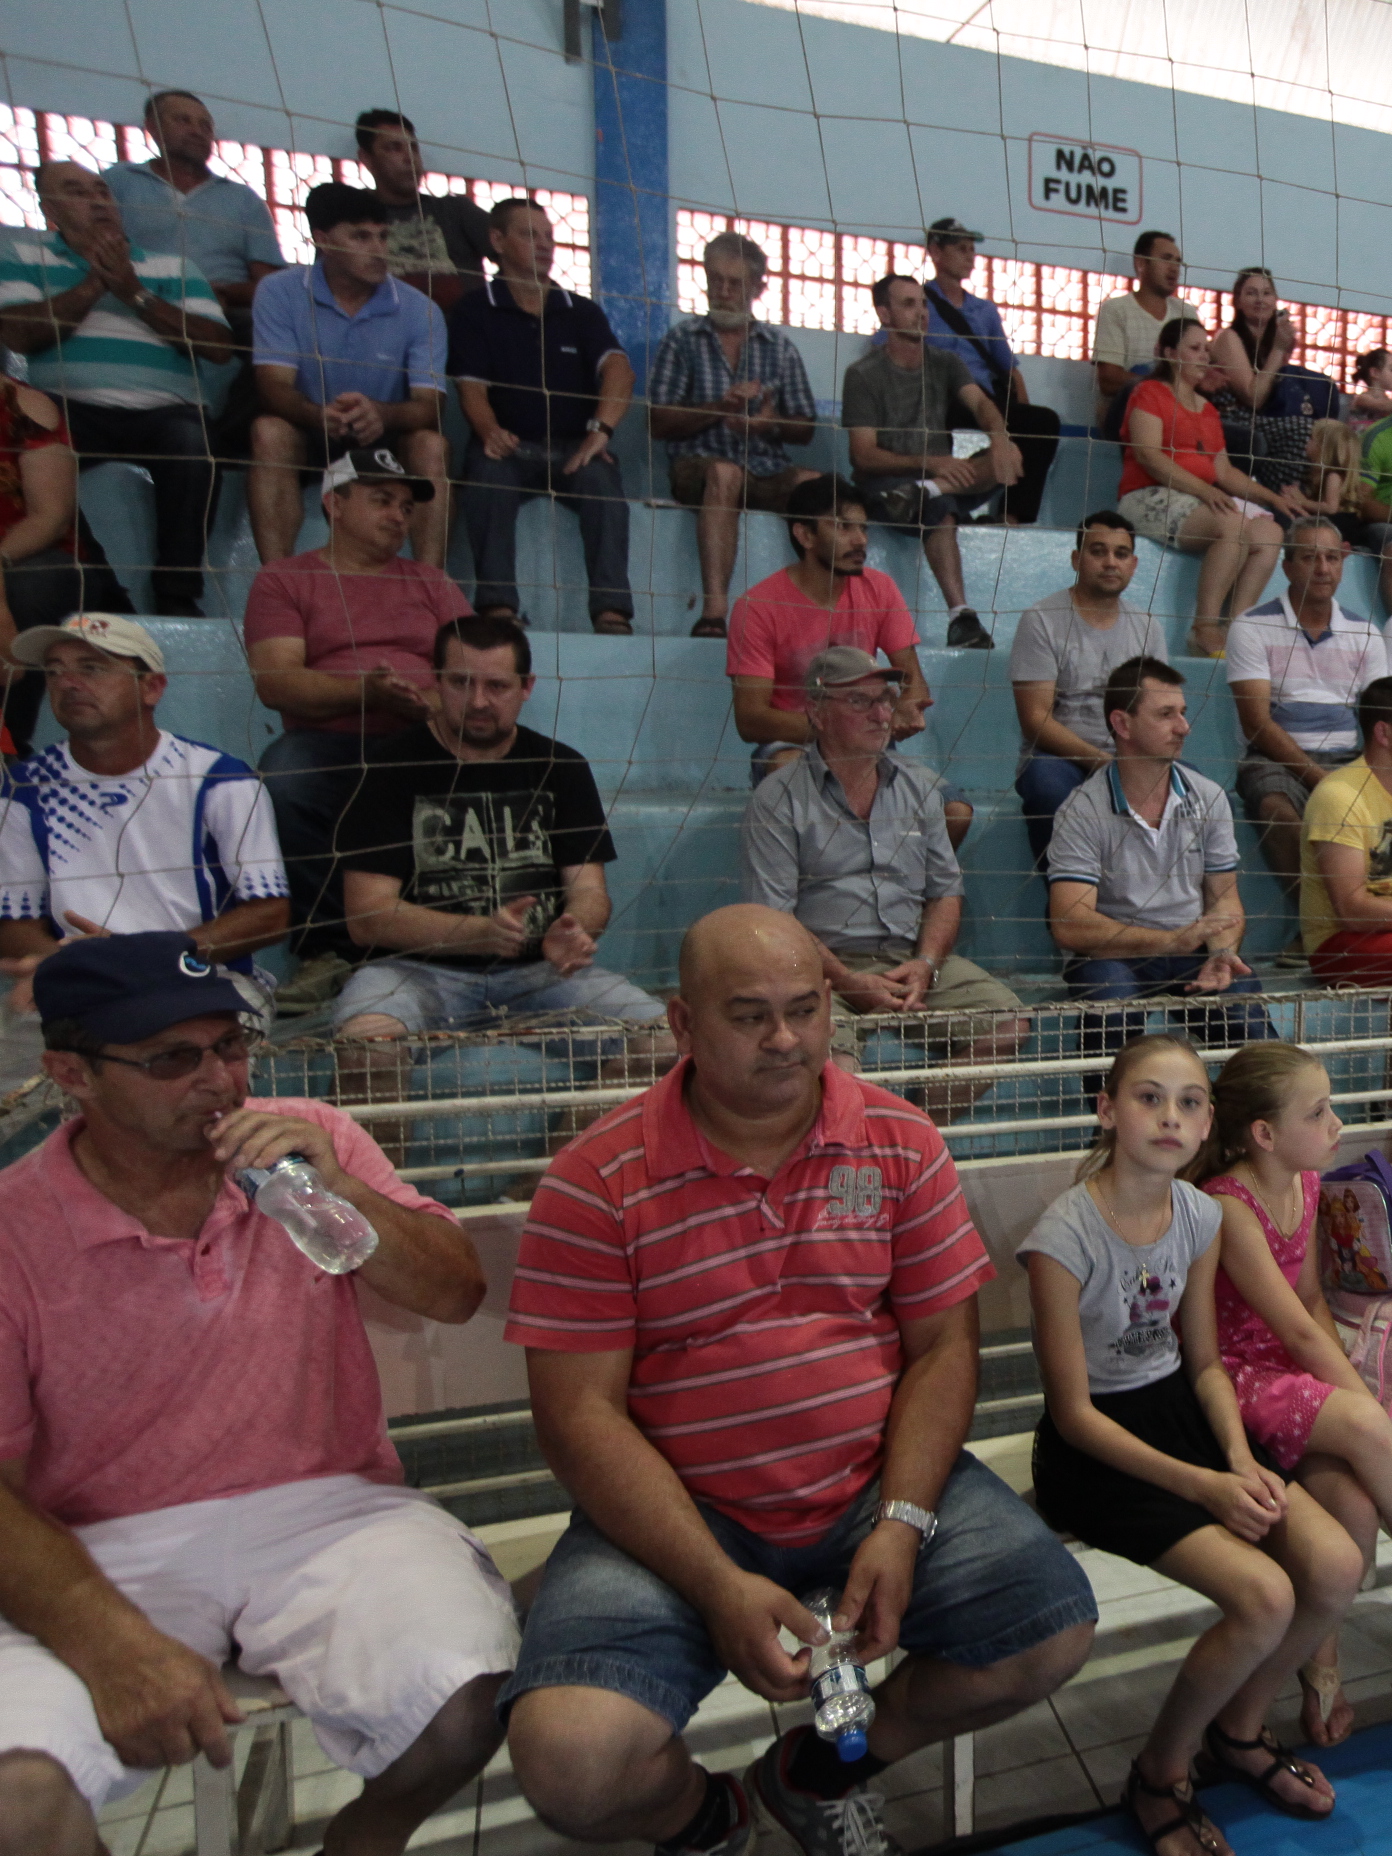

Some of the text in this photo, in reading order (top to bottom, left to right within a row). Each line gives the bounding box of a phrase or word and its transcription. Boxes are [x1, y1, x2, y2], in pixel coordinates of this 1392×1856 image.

[1055, 145, 1116, 179] NÃO
[1043, 177, 1128, 214] FUME
[828, 1165, 883, 1216] 98
